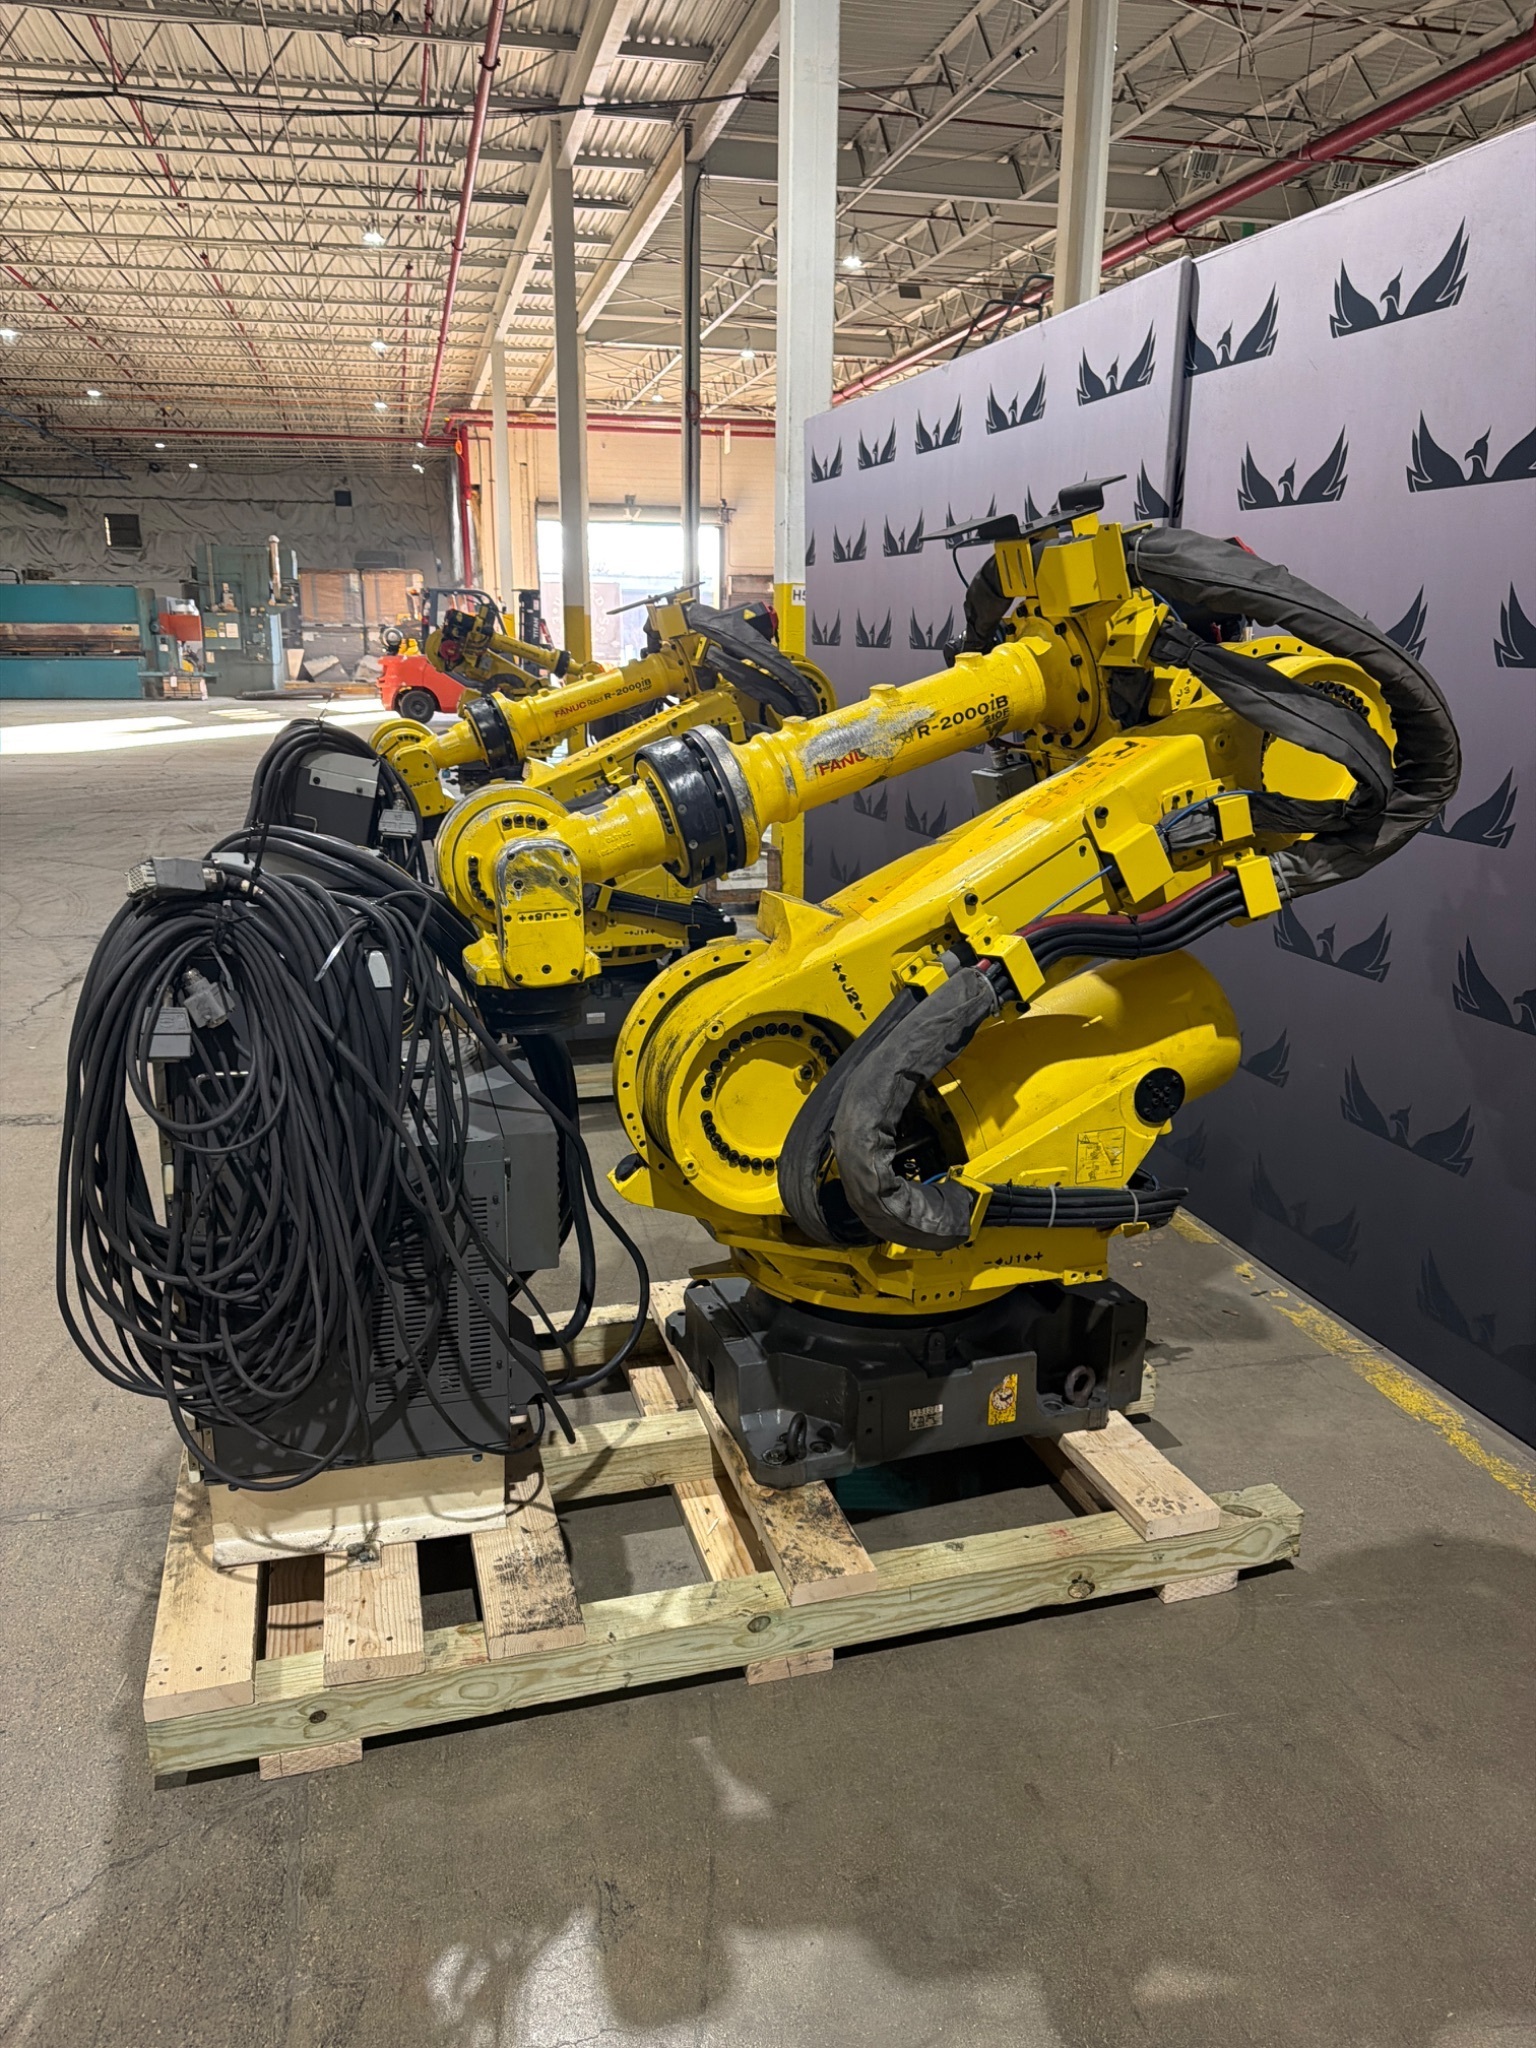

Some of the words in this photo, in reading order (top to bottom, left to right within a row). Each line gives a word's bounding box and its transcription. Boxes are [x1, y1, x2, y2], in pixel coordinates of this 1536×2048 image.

[1192, 170, 1212, 180] S-10
[1332, 181, 1350, 190] S-11
[554, 701, 587, 718] FANUC
[603, 677, 652, 700] R-2000iB
[917, 693, 1009, 739] R-2000iB
[983, 708, 1011, 723] 210F
[817, 748, 869, 776] FANU
